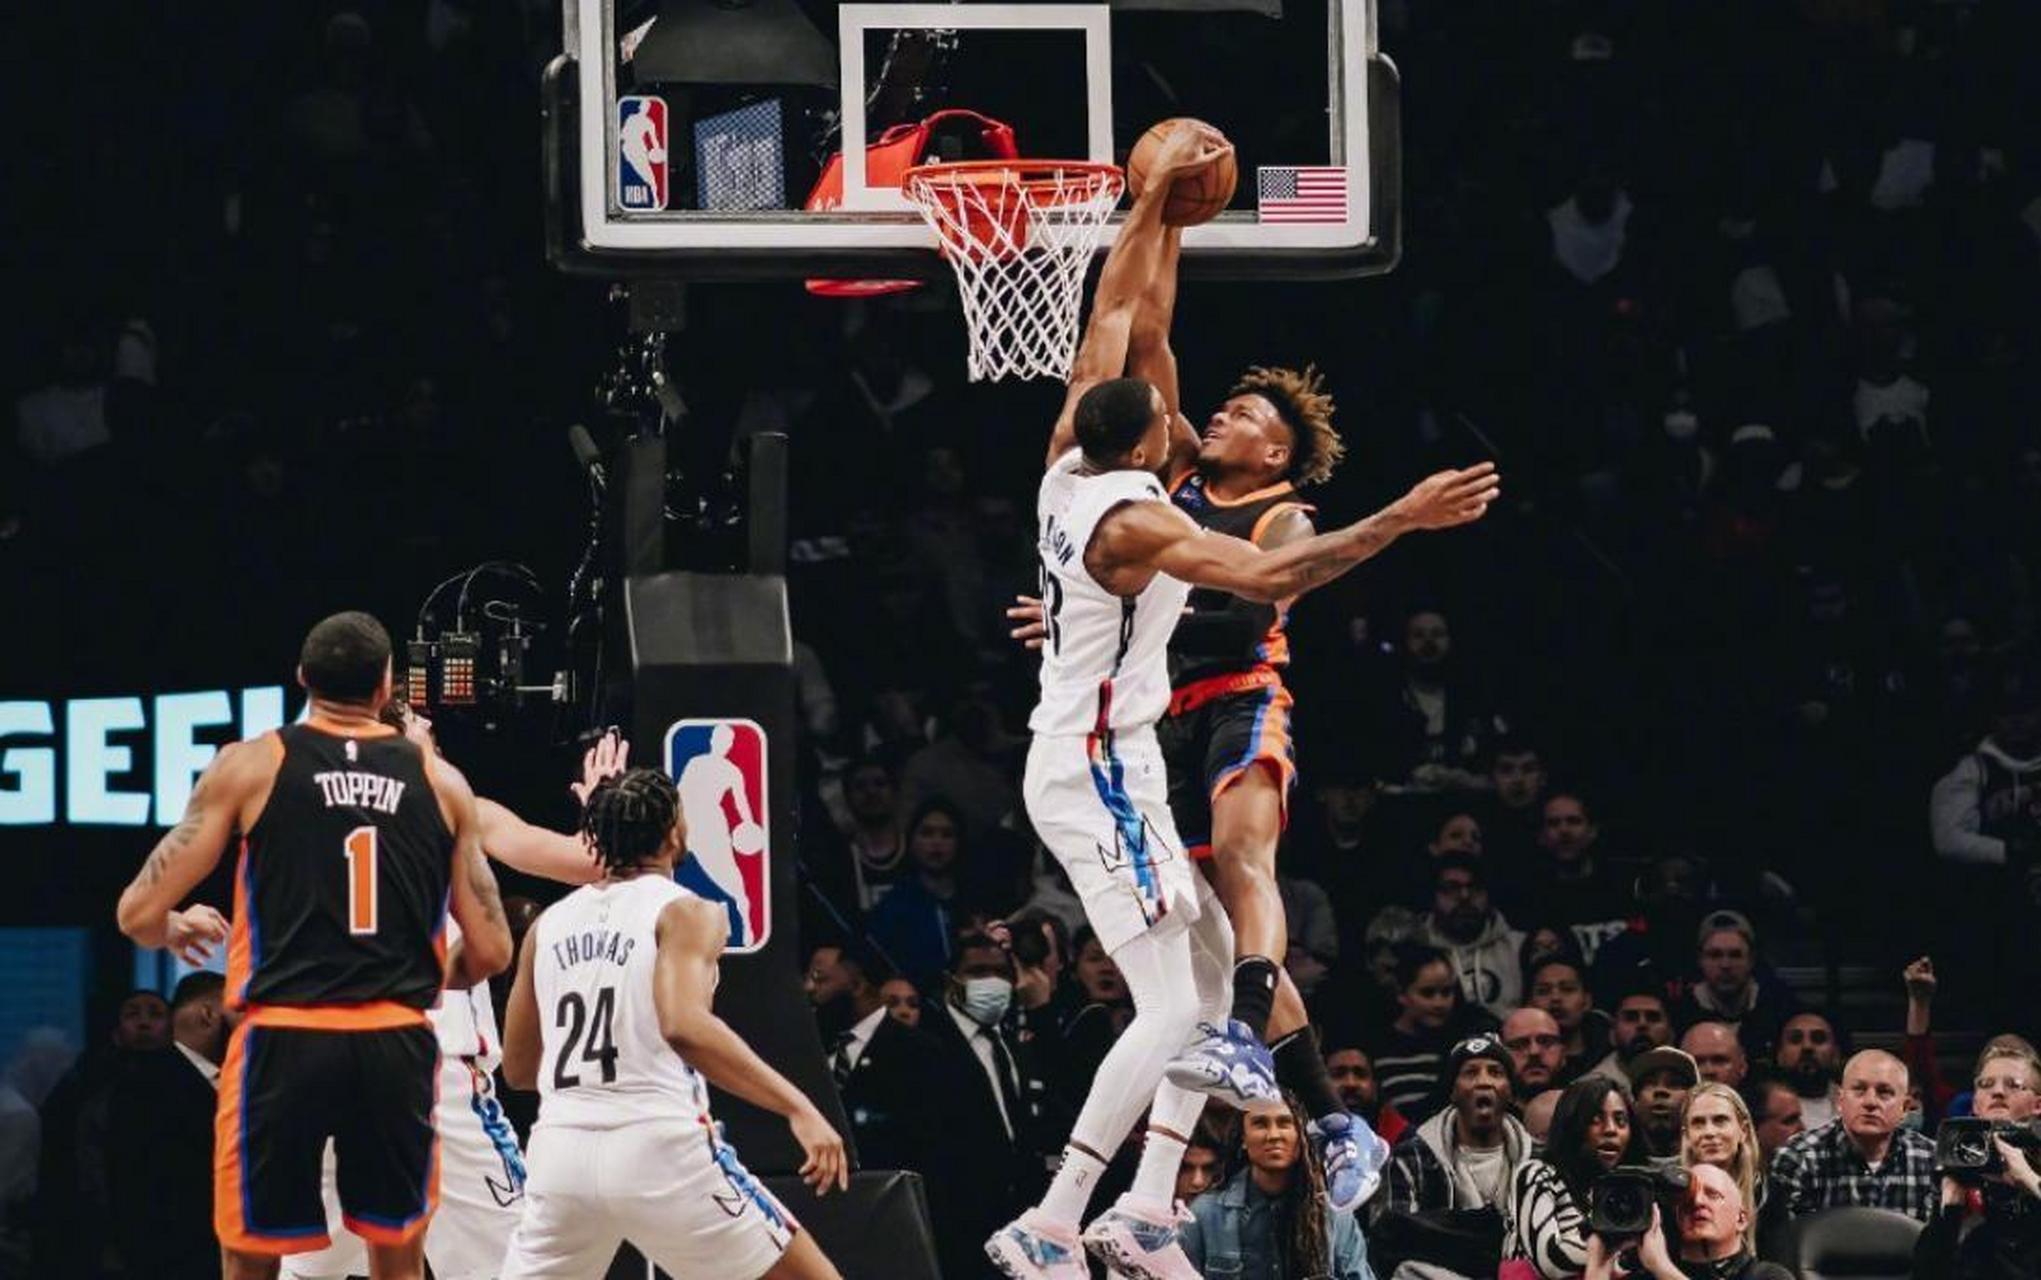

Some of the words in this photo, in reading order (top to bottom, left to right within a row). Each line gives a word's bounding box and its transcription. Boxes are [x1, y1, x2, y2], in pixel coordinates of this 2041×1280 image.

[625, 185, 649, 204] NBA
[0, 686, 310, 826] GEE
[313, 771, 405, 815] TOPPIN
[344, 826, 377, 935] 1
[553, 931, 635, 971] THOMAS
[554, 986, 618, 1090] 24
